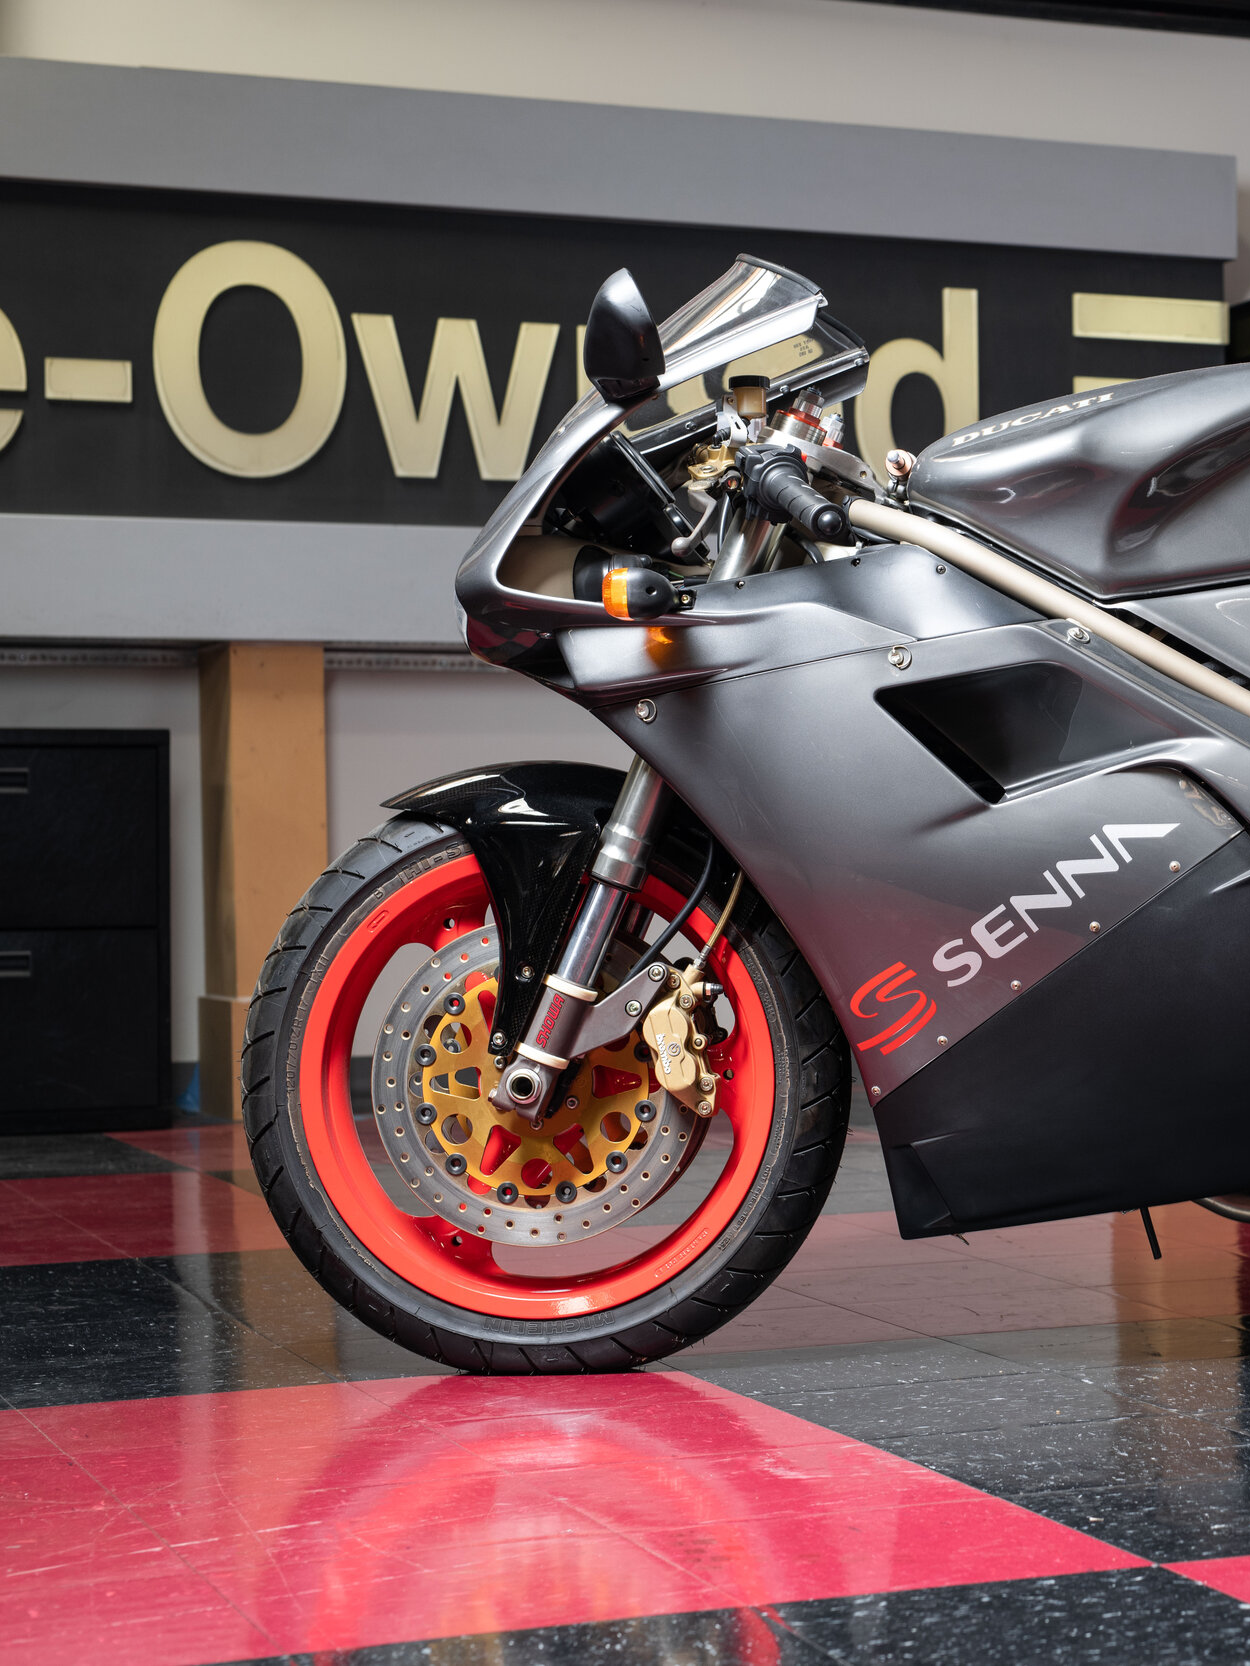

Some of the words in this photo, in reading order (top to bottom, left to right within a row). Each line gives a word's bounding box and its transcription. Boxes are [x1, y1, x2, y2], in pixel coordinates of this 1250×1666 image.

[951, 392, 1115, 448] DUCATI
[400, 839, 472, 883] HI-S
[932, 822, 1182, 988] SENNA
[535, 993, 566, 1049] SHOWA
[284, 1040, 300, 1093] 120/70
[656, 1032, 672, 1076] brembo
[482, 1308, 616, 1335] MICHELIN
